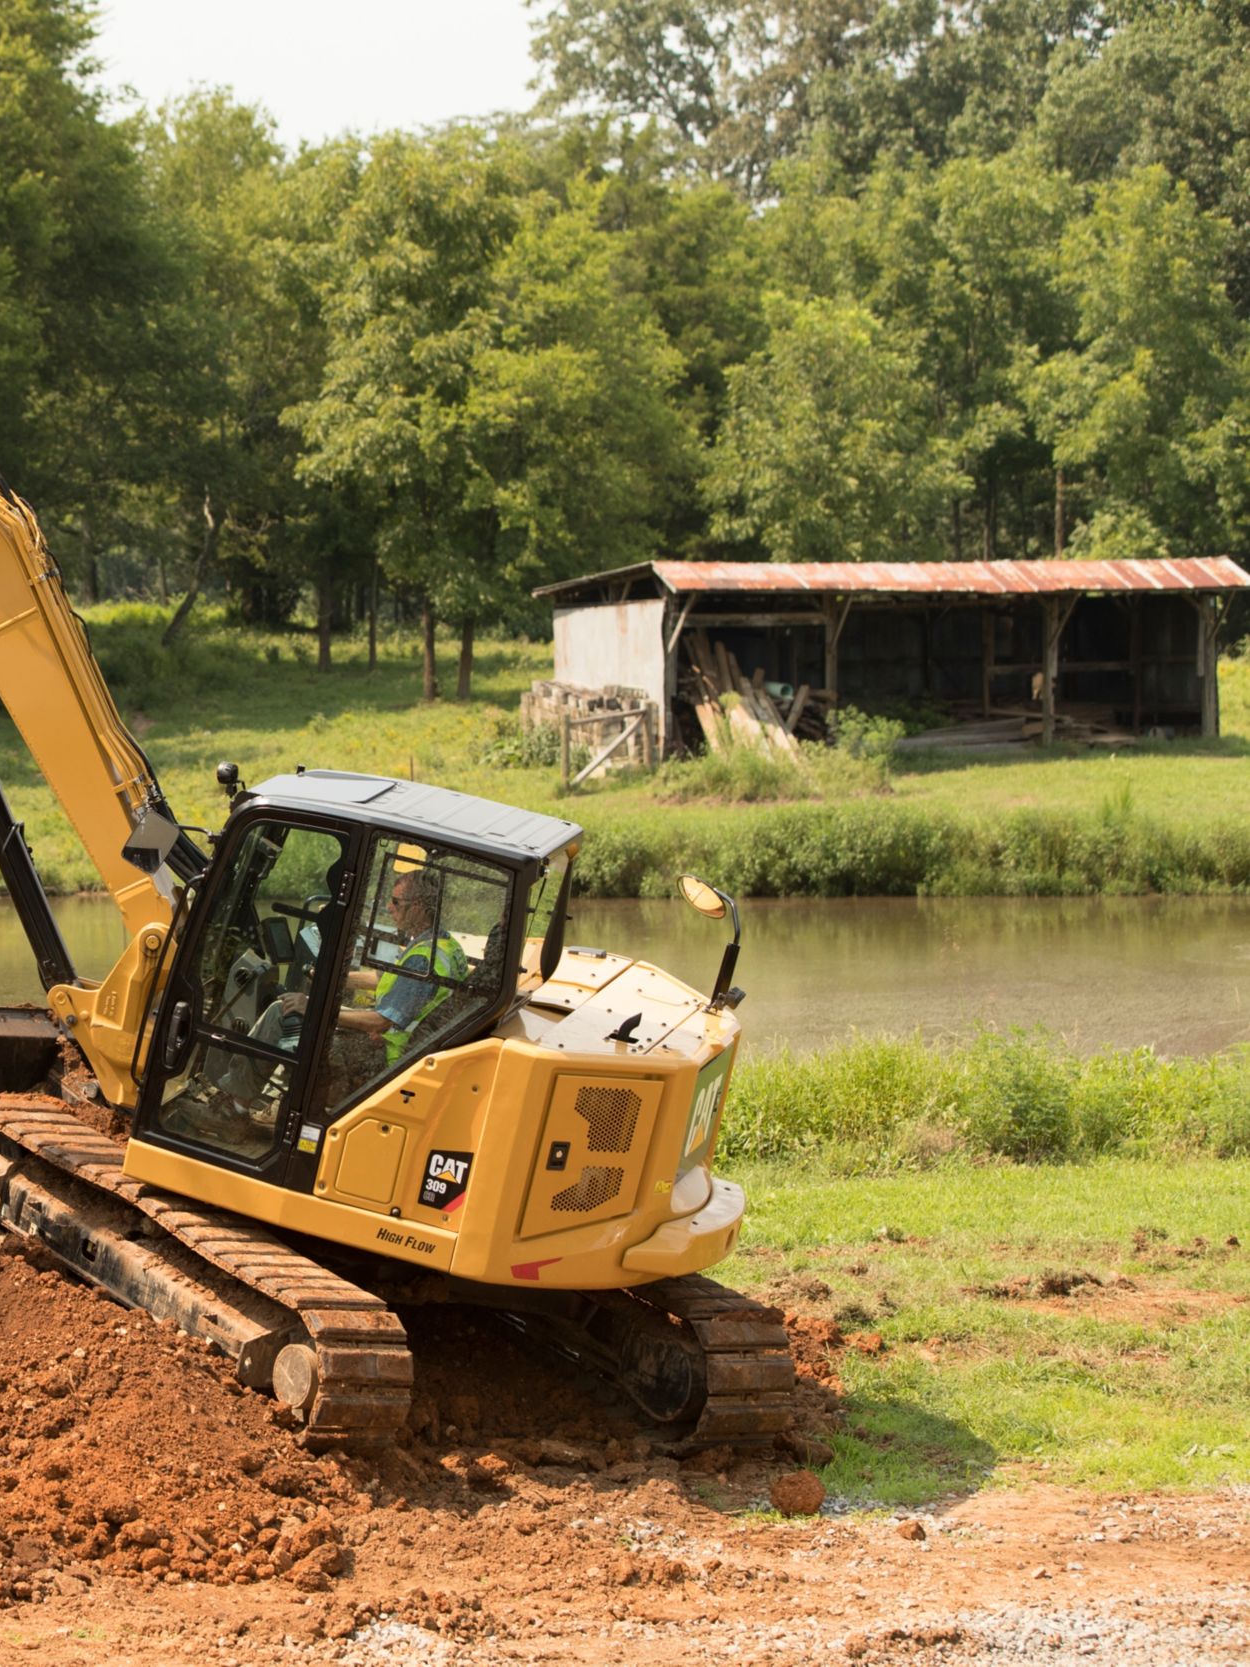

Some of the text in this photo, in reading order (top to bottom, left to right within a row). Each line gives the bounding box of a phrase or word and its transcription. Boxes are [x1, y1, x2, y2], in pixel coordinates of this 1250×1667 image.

[684, 1073, 723, 1157] CAT
[429, 1154, 468, 1184] CAT
[425, 1178, 447, 1194] 309
[376, 1227, 436, 1253] HIGH FLOW
